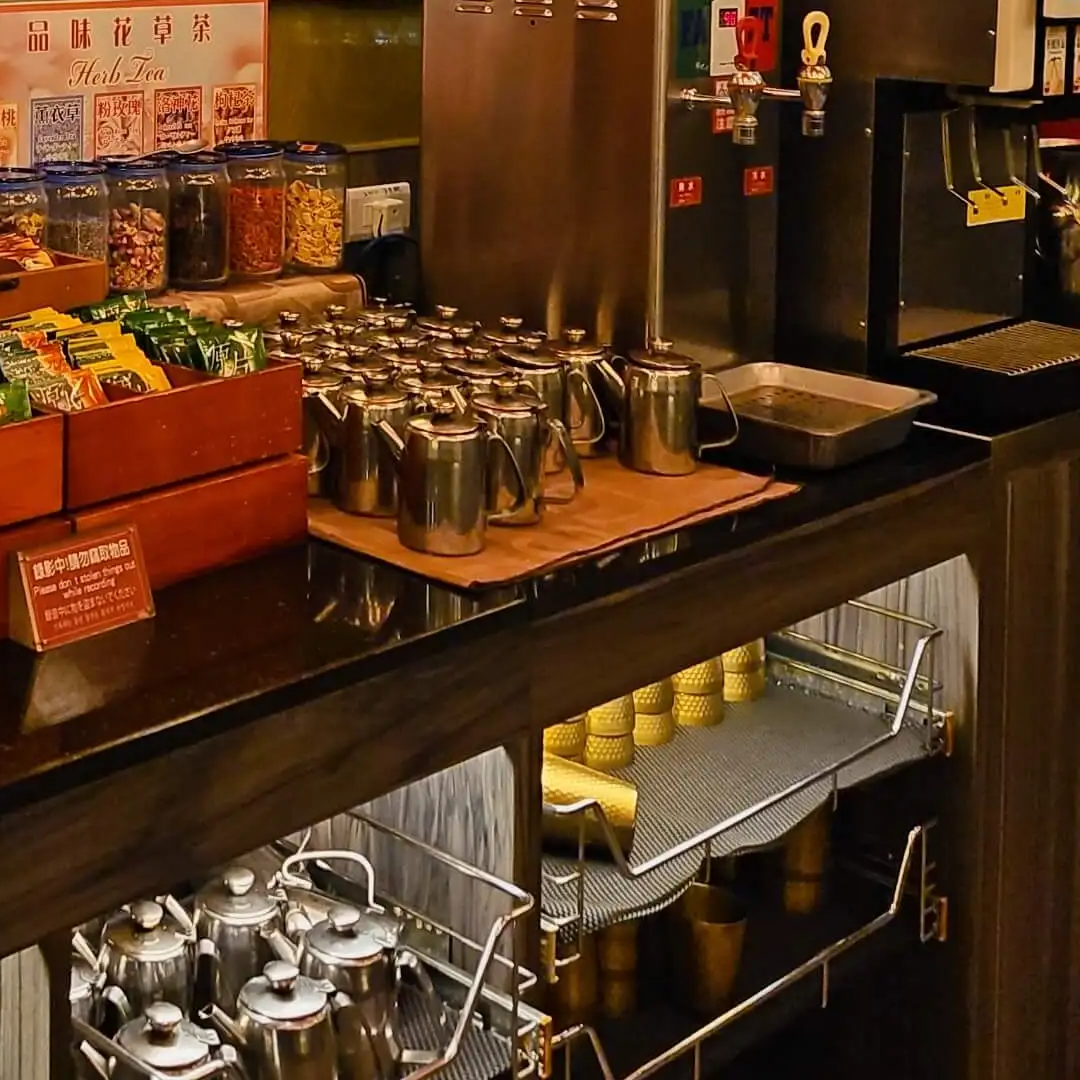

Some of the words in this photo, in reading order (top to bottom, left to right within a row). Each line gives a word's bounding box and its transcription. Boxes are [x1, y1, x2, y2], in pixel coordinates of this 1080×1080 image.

[28, 13, 211, 52] 品味花草茶
[69, 57, 122, 87] Herb
[126, 49, 166, 84] Tea
[97, 100, 141, 118] 粉玫瑰
[158, 94, 199, 114] 洛神花
